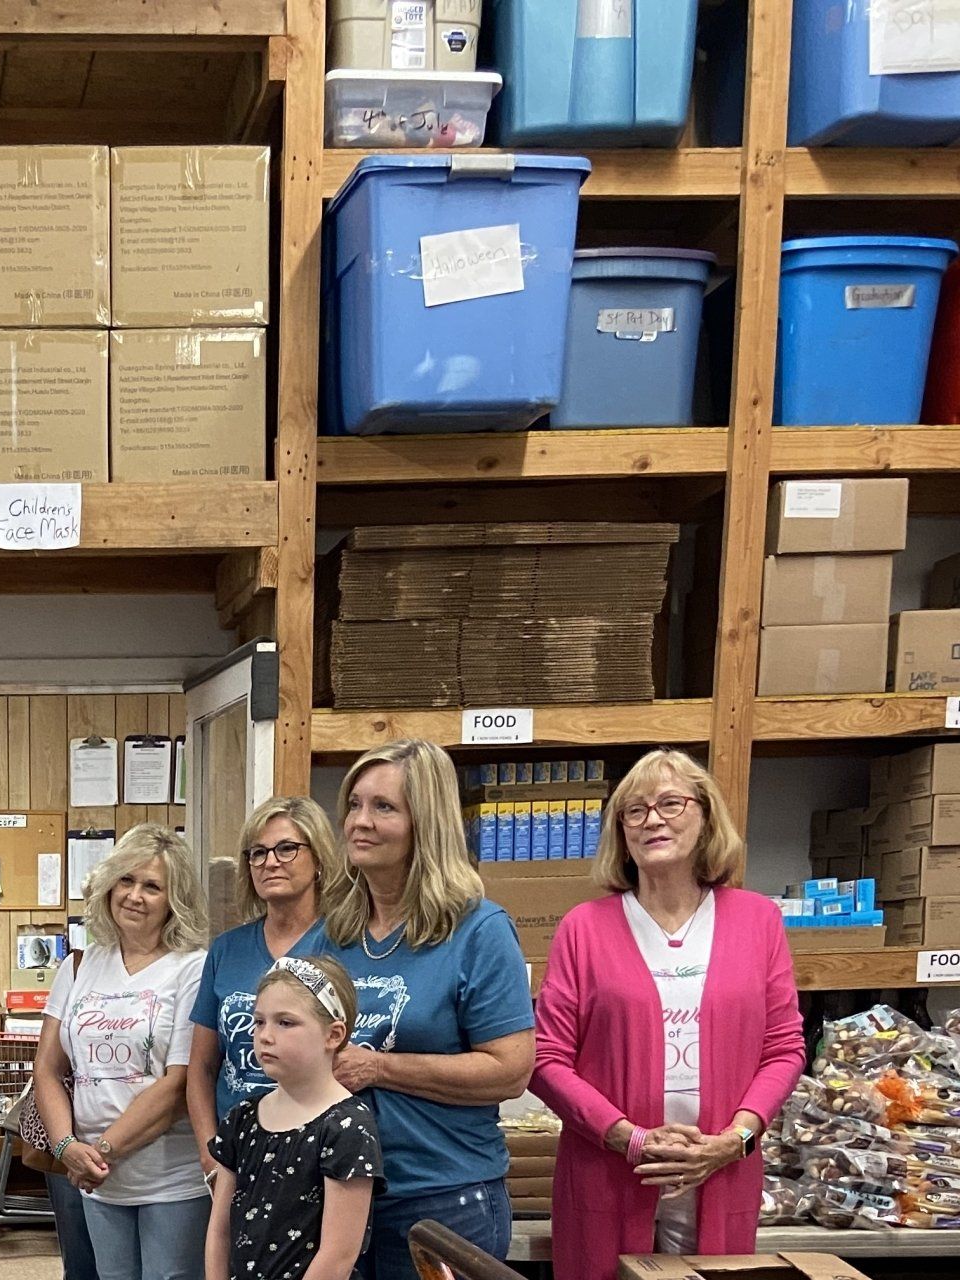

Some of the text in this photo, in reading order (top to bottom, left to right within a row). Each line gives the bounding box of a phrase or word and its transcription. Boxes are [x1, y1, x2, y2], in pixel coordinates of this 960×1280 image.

[403, 13, 424, 21] TOTE
[431, 247, 507, 280] Halloween
[40, 516, 79, 540] Mask
[473, 715, 517, 728] FOOD
[516, 914, 563, 924] Always Sav
[931, 954, 960, 965] FOO
[77, 1010, 145, 1036] Power
[104, 1032, 114, 1040] of
[668, 1028, 682, 1039] of
[88, 1042, 132, 1064] 100
[239, 1047, 263, 1071] 10
